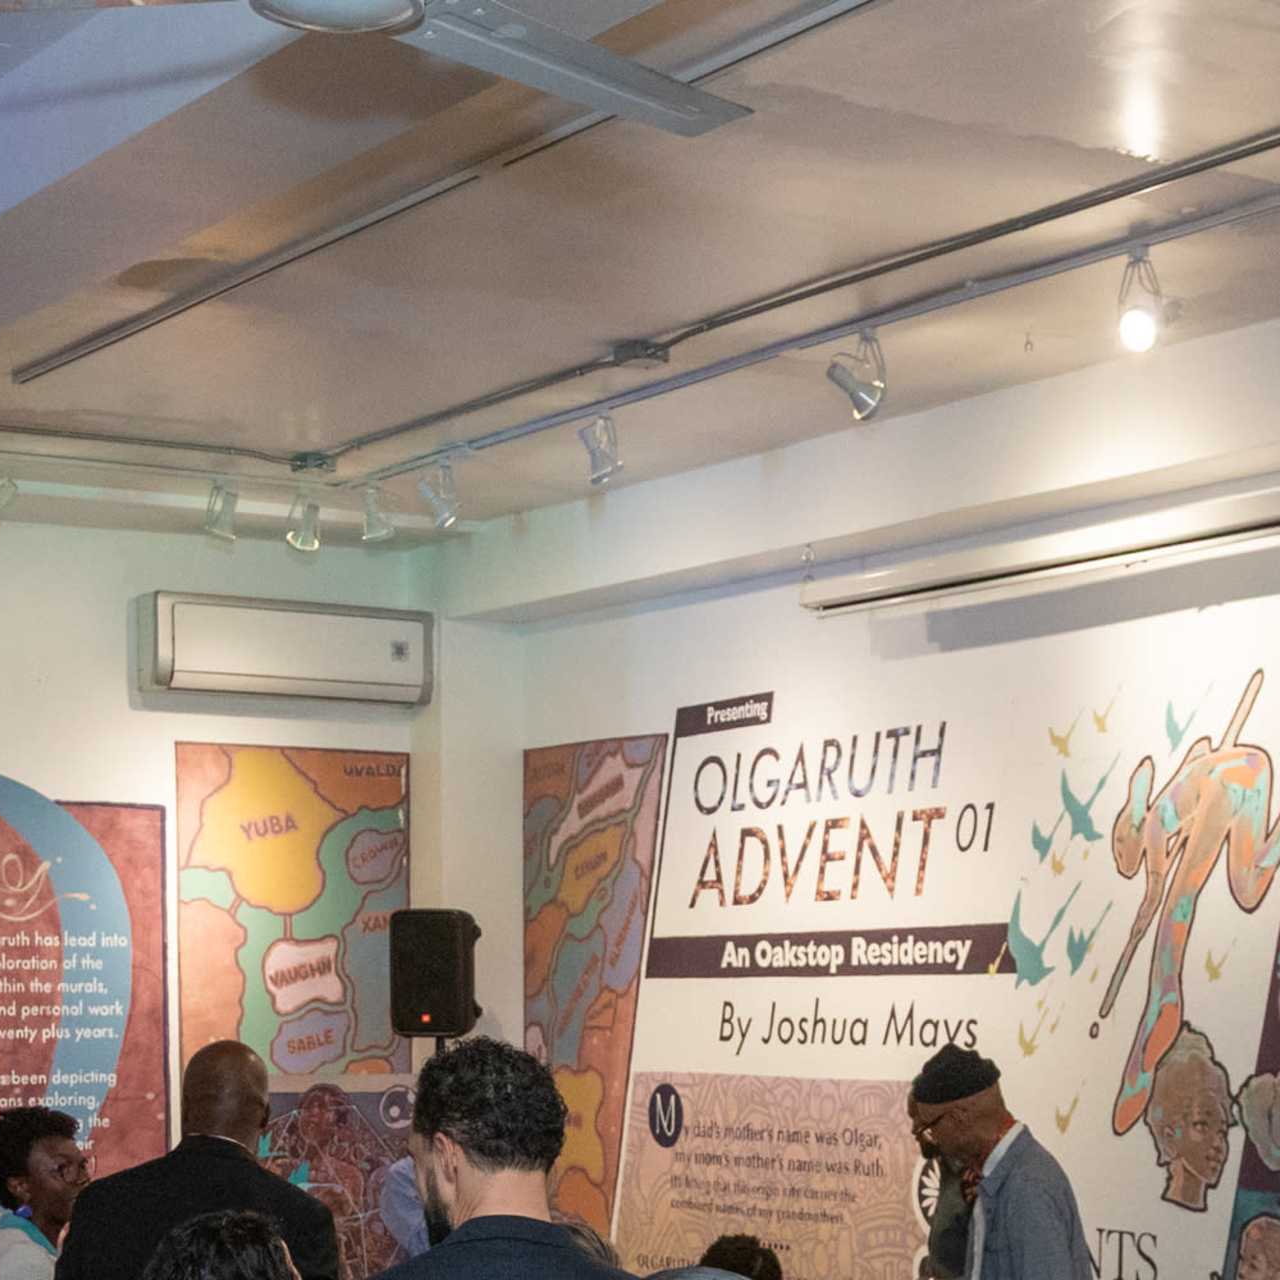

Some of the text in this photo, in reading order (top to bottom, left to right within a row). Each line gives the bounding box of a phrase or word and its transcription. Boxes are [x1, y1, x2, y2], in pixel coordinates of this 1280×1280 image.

[706, 698, 769, 725] Presenting
[693, 721, 947, 815] OLGARUTH
[241, 810, 299, 841] YUBA
[689, 802, 996, 910] ADVENT 01
[35, 930, 61, 948] has
[64, 929, 97, 948] lead
[101, 930, 129, 948] into
[63, 953, 79, 971] of
[81, 952, 104, 971] the
[721, 936, 972, 973] An Oakstop Residency
[270, 956, 333, 990] VAUGHN
[29, 976, 53, 994] the
[57, 976, 108, 996] murals,
[20, 999, 84, 1021] personal
[88, 999, 124, 1017] work
[42, 1023, 71, 1043] plus
[75, 1025, 120, 1042] years.
[719, 997, 979, 1055] By Joshua Mays
[286, 1028, 335, 1054] SABLE
[10, 1069, 47, 1086] been
[51, 1069, 118, 1090] depicting
[88, 1113, 111, 1130] the
[776, 1128, 811, 1144] name
[814, 1130, 839, 1145] was
[786, 1158, 820, 1173] name
[824, 1160, 849, 1176] was
